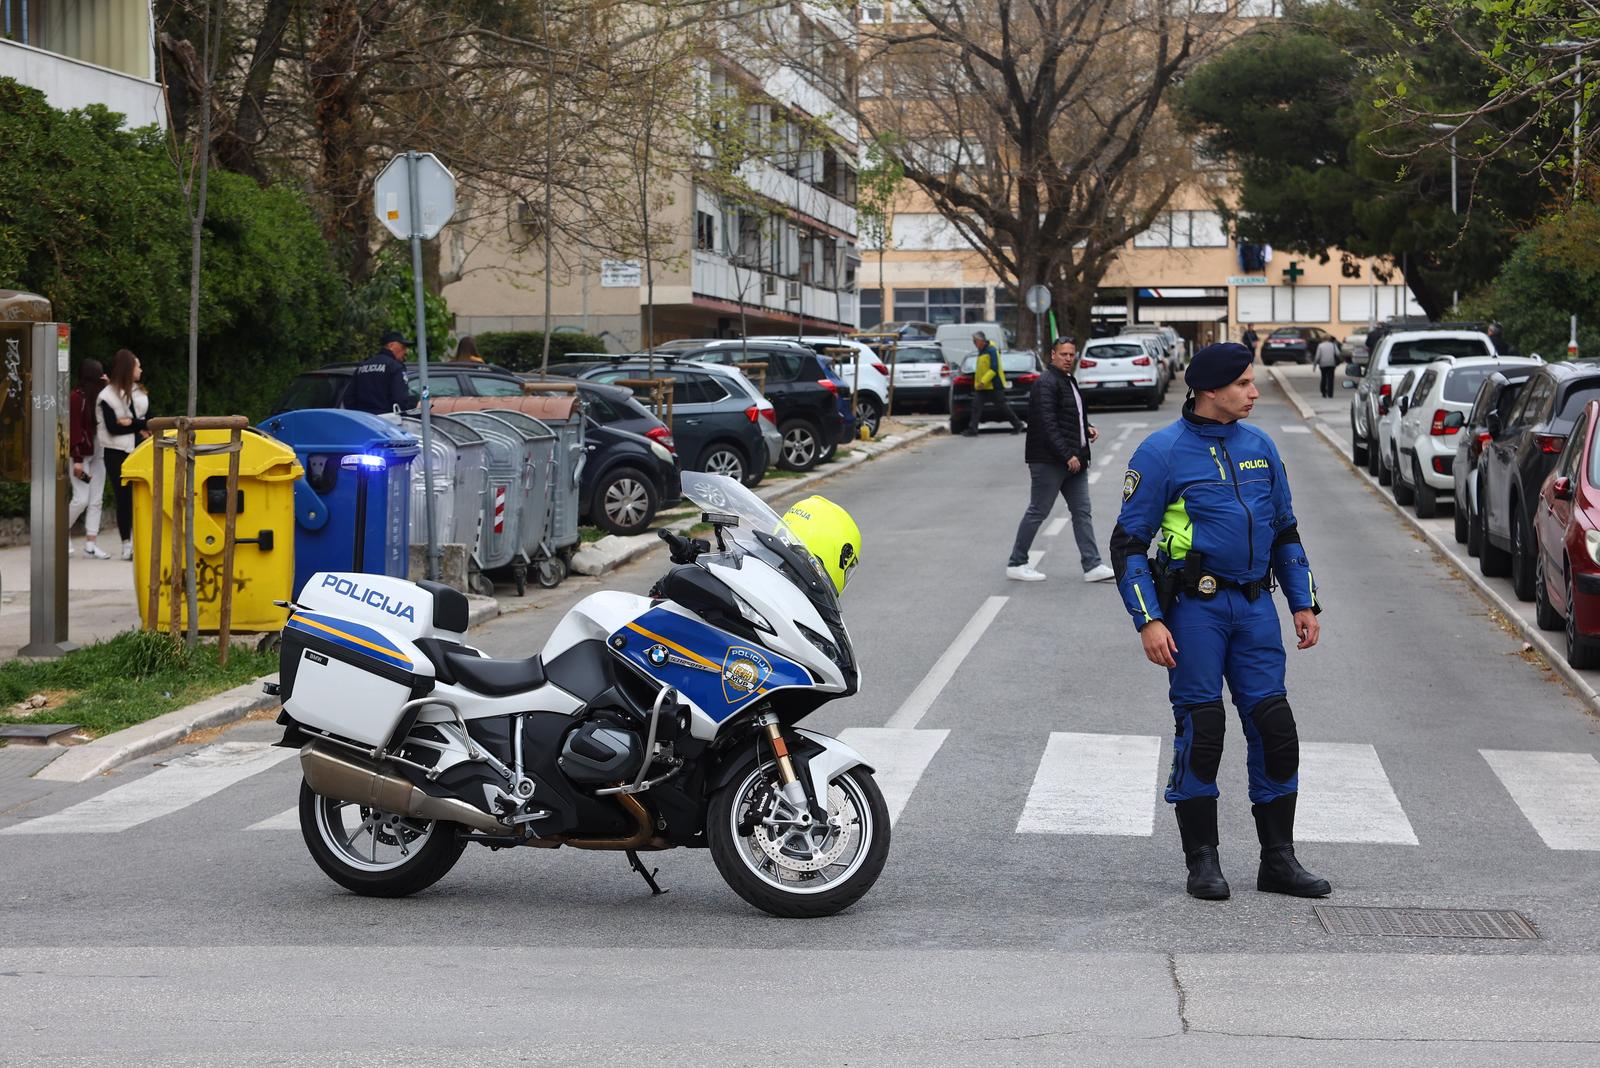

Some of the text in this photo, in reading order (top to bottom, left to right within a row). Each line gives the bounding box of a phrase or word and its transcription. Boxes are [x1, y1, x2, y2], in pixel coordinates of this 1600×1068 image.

[321, 574, 415, 623] POLICIJA
[309, 653, 323, 662] BMW
[731, 649, 770, 674] POLICIJA
[730, 674, 749, 687] MUP
[757, 792, 769, 813] brembo
